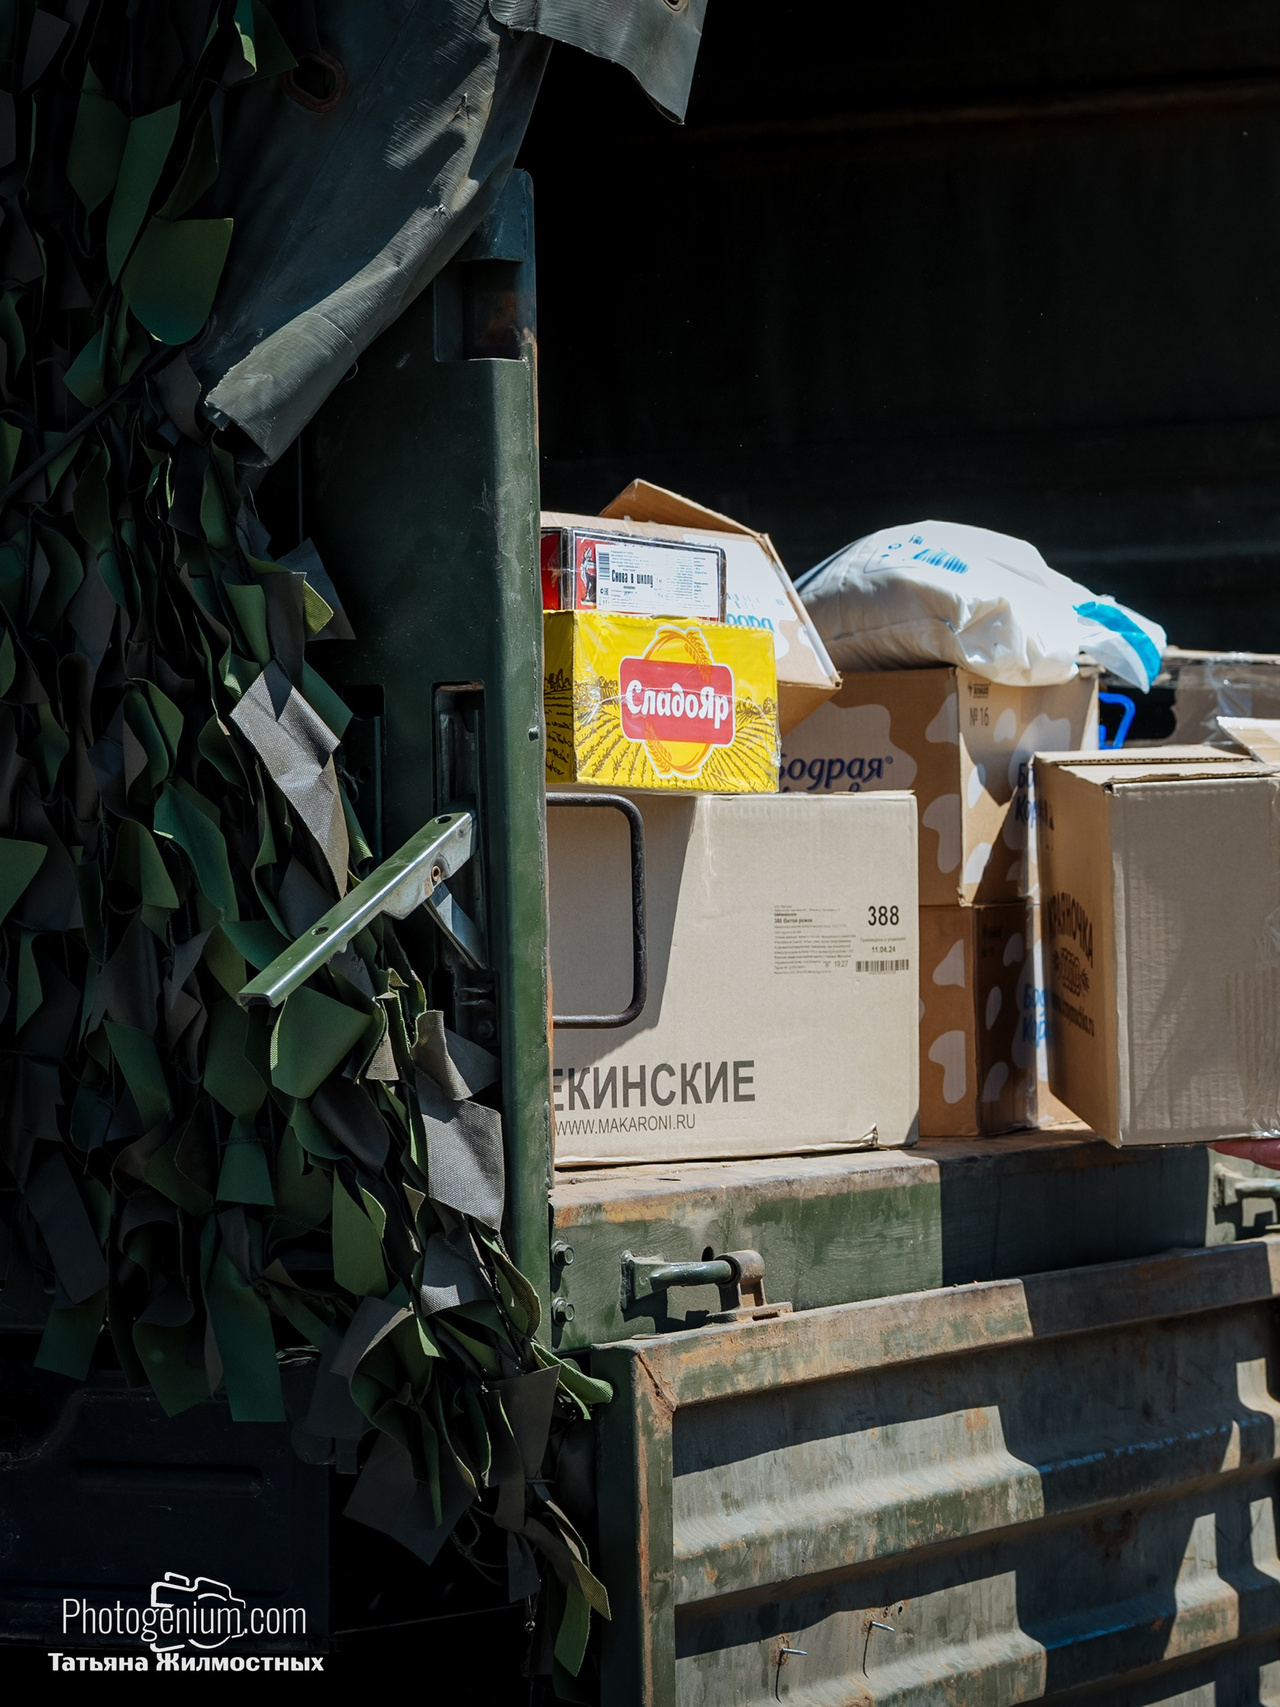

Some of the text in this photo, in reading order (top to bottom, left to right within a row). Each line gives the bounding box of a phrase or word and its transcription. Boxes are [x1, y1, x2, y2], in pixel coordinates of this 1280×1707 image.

[625, 679, 729, 729] СладоЯр
[980, 707, 989, 726] 16
[868, 905, 899, 926] 388
[556, 1114, 696, 1136] WWW.MAKARONI.RU
